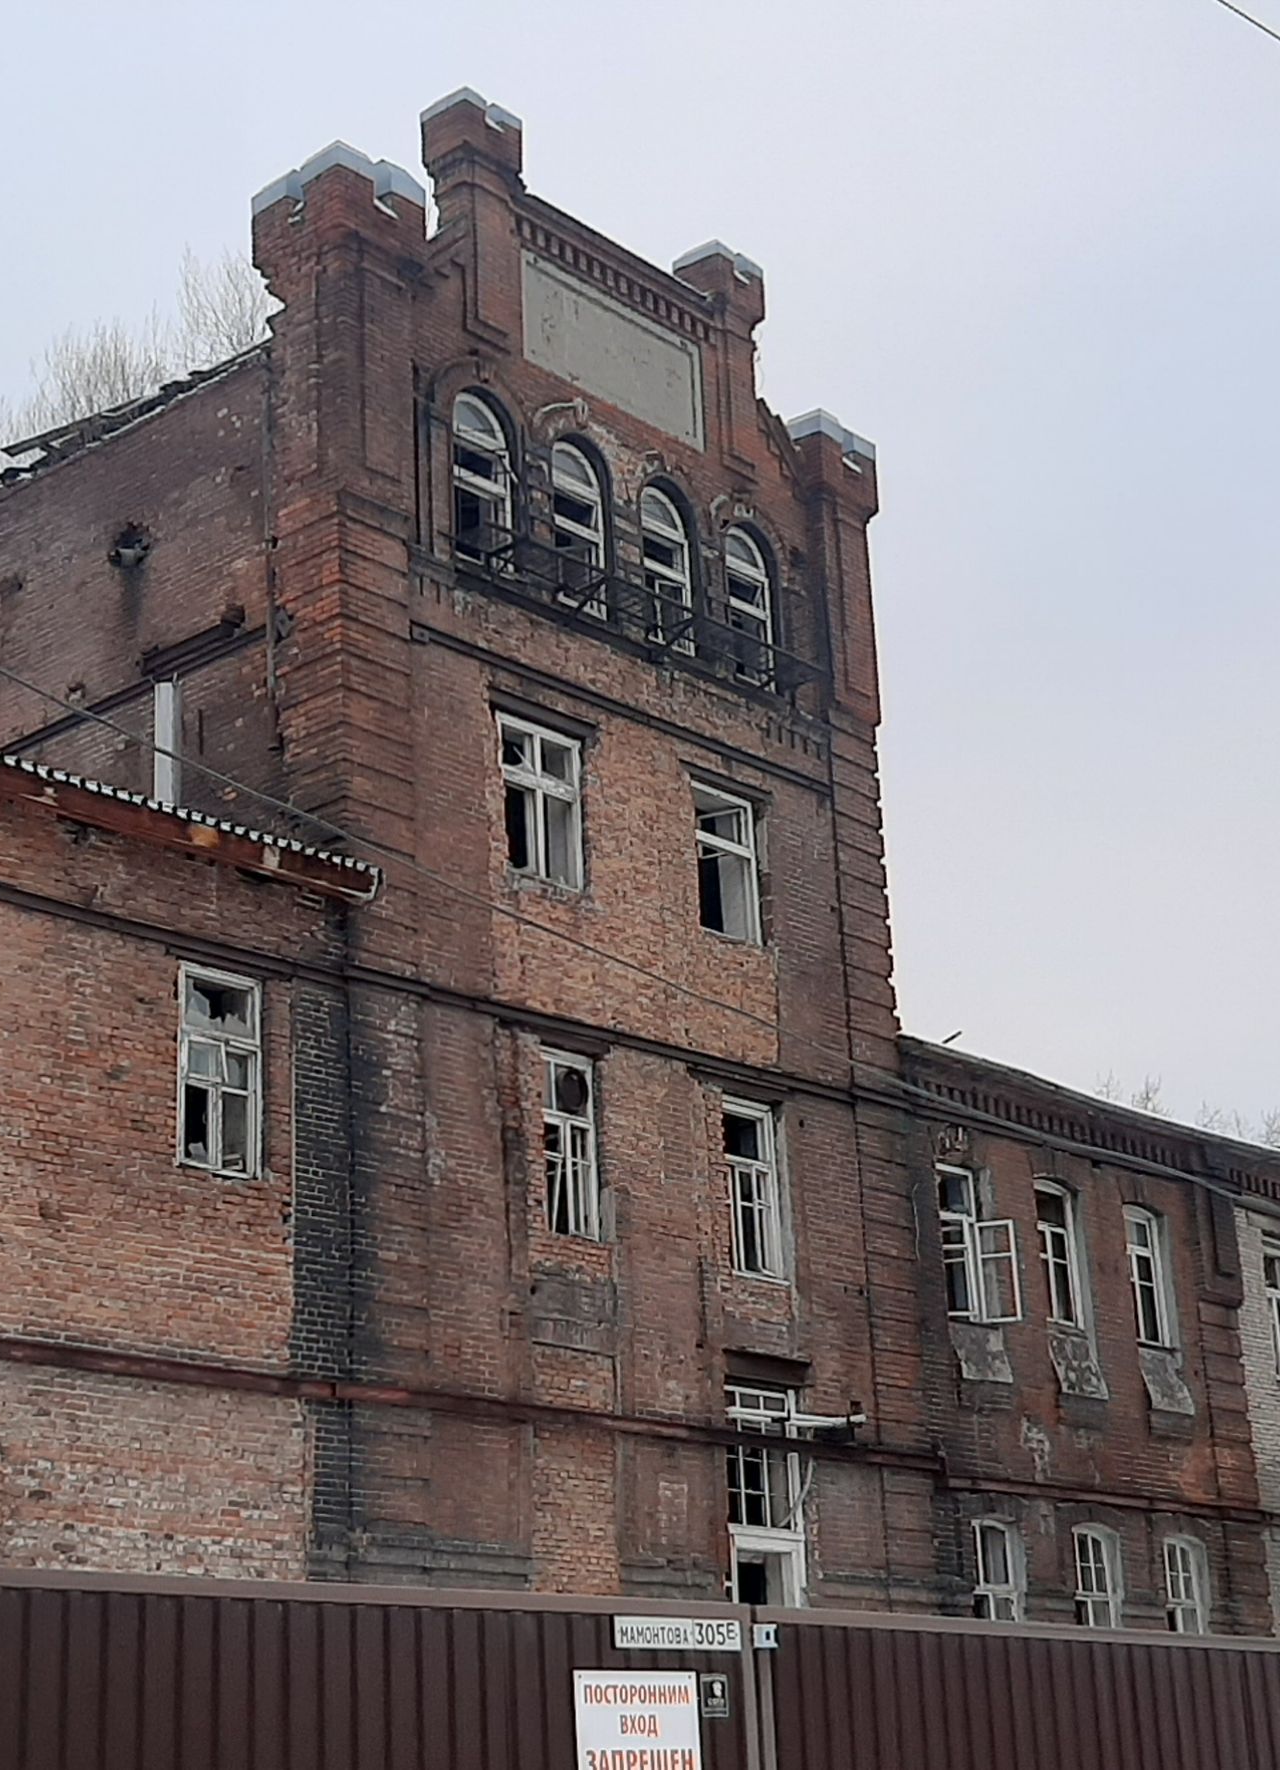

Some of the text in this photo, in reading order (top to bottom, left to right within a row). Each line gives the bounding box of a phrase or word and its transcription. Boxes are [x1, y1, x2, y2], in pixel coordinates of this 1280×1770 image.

[620, 1625, 689, 1645] МАМОНТОВА
[583, 1683, 689, 1704] ПОСТОРОННИМ
[619, 1714, 658, 1737] ВХОД
